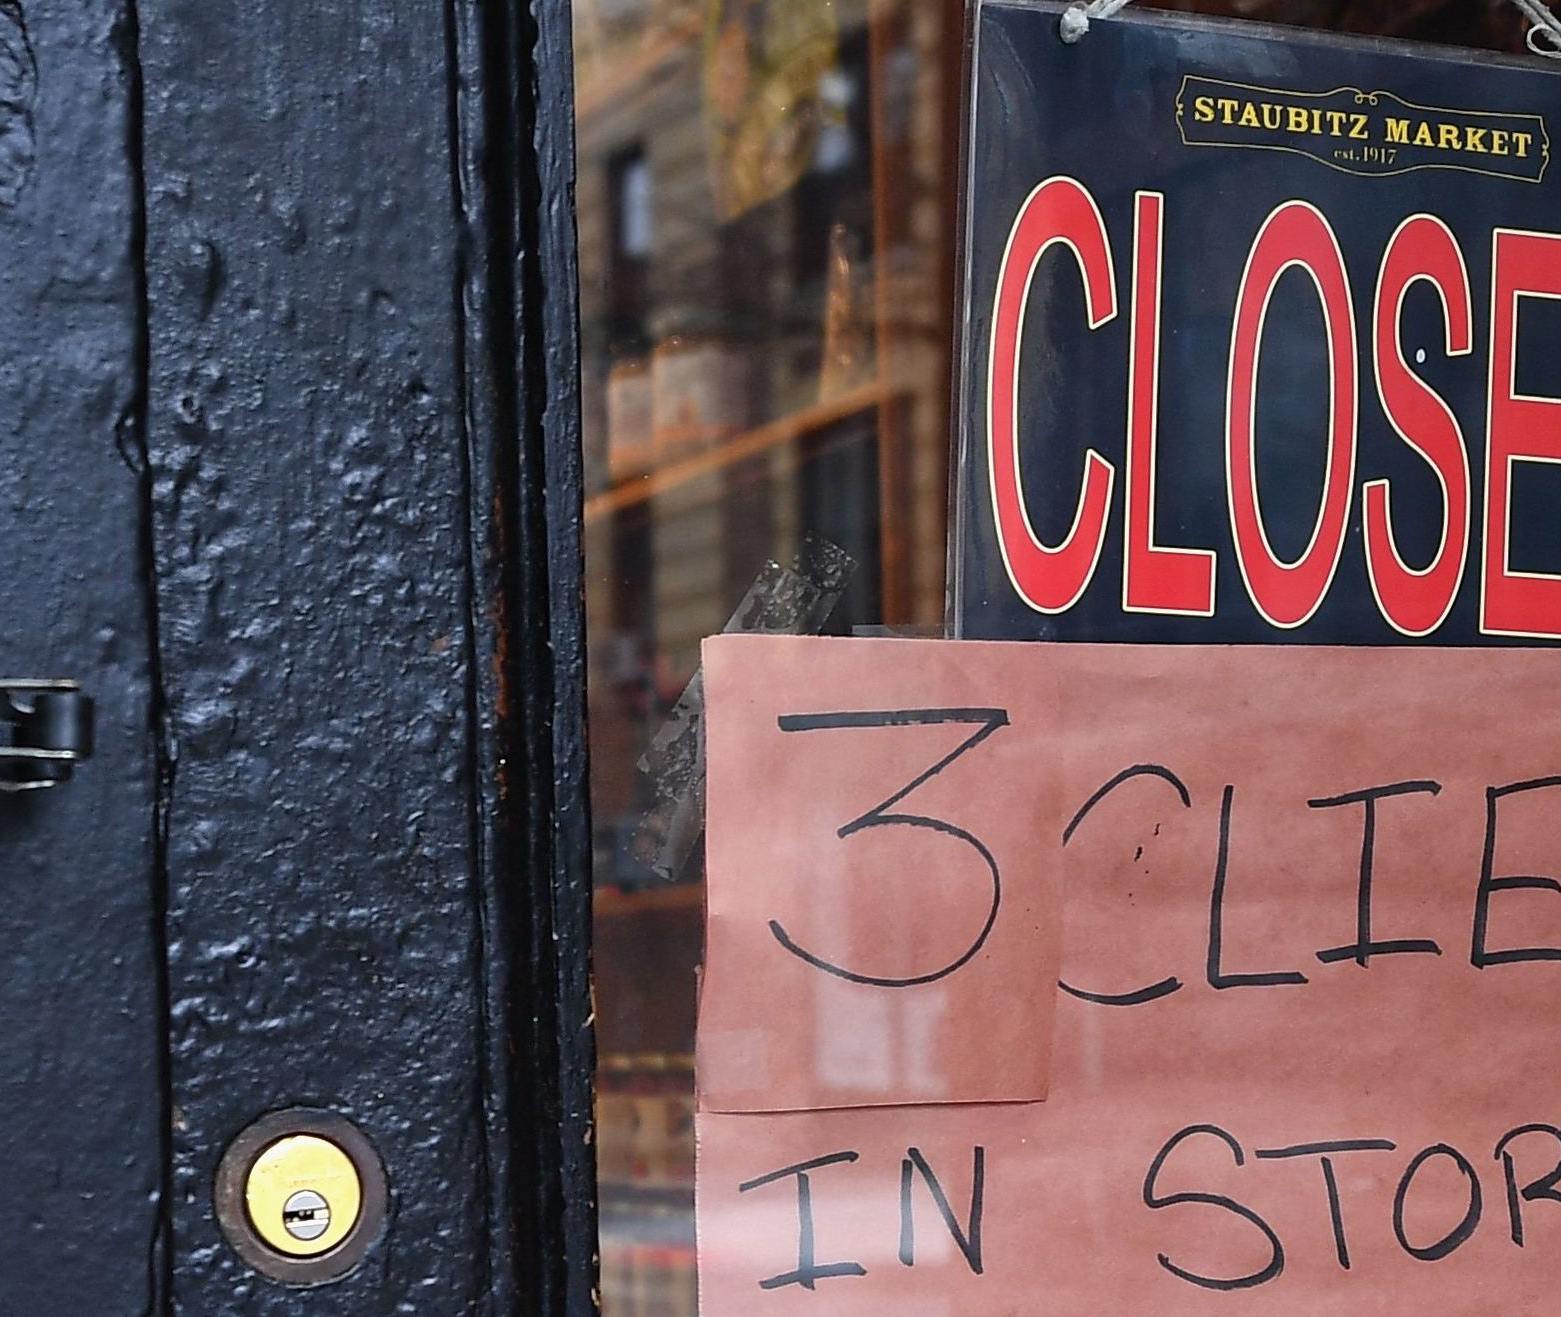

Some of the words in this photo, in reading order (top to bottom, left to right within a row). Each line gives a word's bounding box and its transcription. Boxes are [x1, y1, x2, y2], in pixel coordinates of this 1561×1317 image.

[1193, 96, 1370, 139] STAUBITZ
[1384, 118, 1533, 158] MARKET
[770, 708, 1010, 987] 3
[740, 1146, 984, 1290] IN
